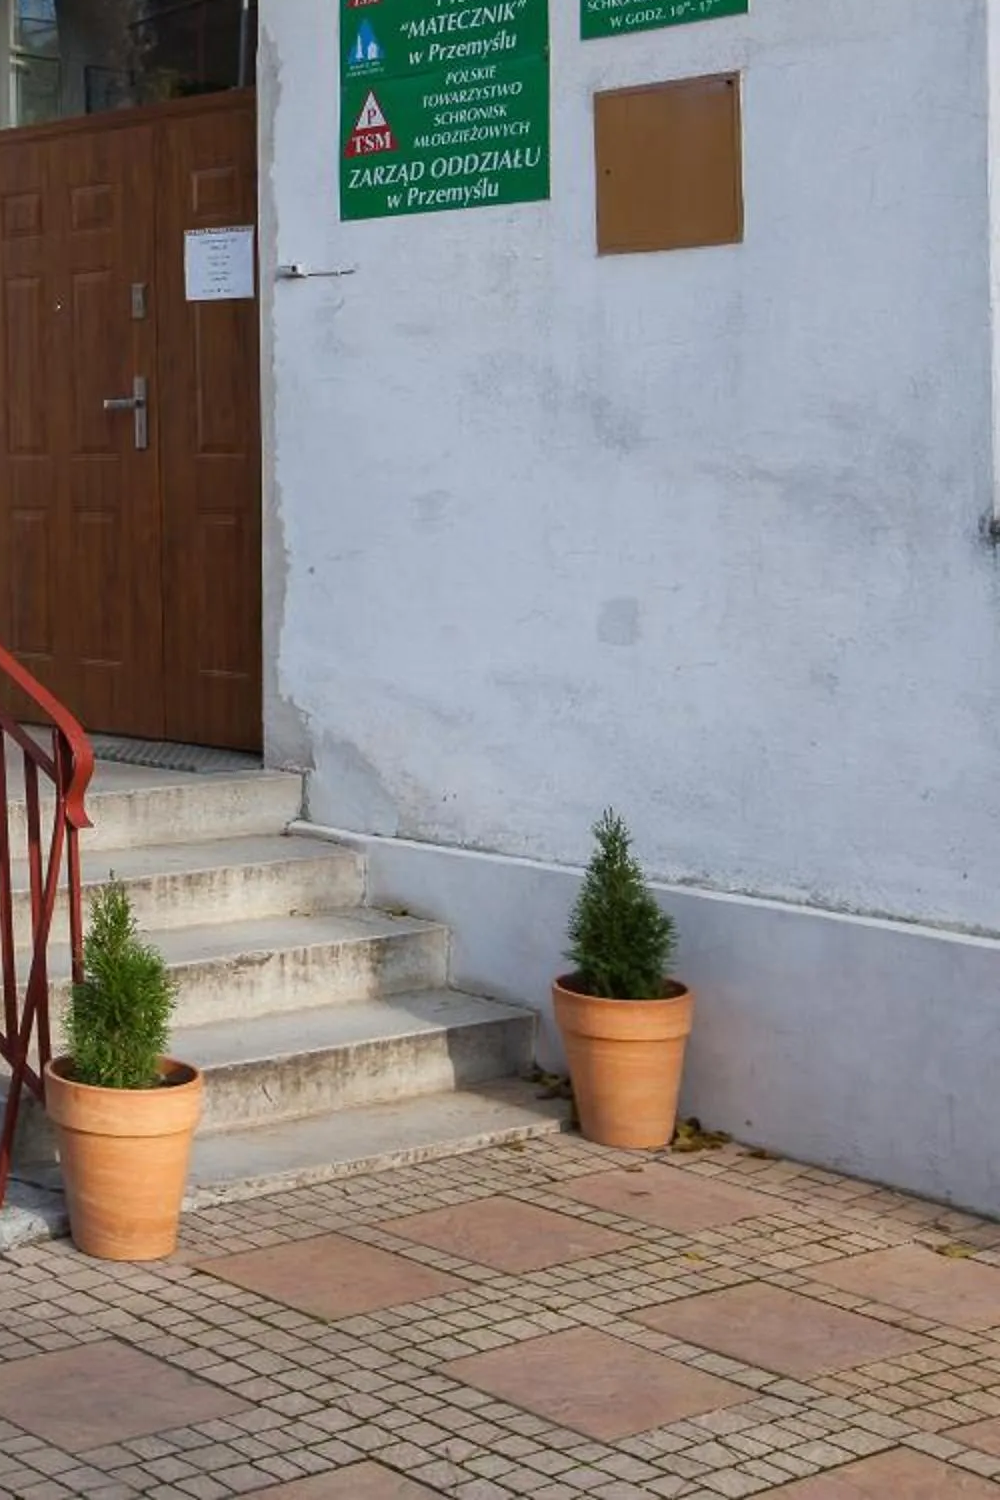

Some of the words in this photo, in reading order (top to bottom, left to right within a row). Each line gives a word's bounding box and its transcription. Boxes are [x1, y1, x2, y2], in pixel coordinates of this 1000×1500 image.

[610, 15, 622, 29] W
[625, 8, 666, 25] GODZ.
[409, 52, 423, 65] w
[428, 29, 517, 62] Przemyślu
[445, 65, 497, 85] POLSKIE
[422, 81, 523, 108] TOWARZYSTWO
[367, 109, 377, 125] P
[433, 105, 508, 127] SCHRONISK
[352, 131, 392, 153] TSM
[413, 121, 531, 149] MŁODZIEŻOWYCH
[348, 161, 425, 189] ZARZĄD
[430, 147, 541, 179] ODDZIAŁU
[387, 195, 401, 209] w
[407, 177, 499, 207] Przemyślu
